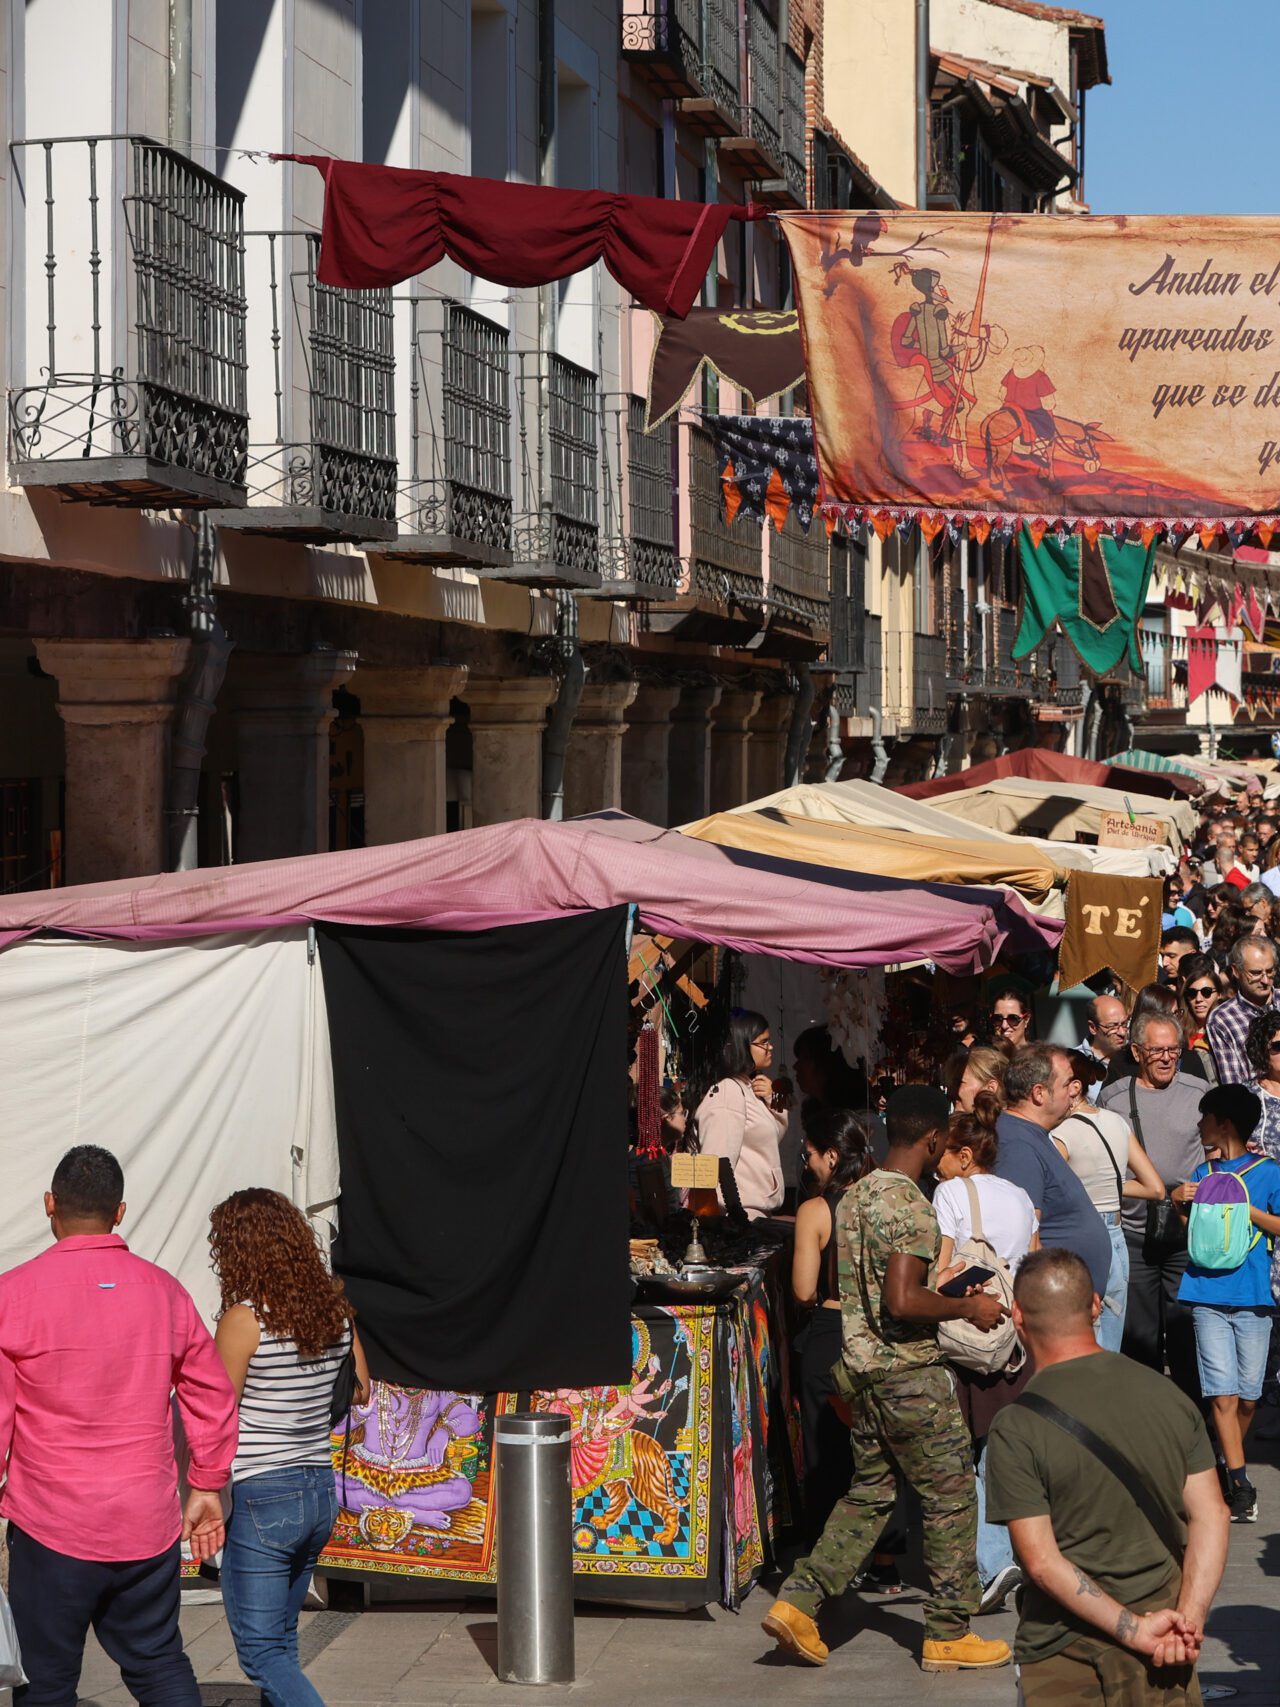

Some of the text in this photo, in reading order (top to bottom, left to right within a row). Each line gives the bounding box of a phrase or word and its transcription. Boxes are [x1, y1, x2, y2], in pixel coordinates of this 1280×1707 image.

[1128, 253, 1241, 296] Andan
[1118, 315, 1274, 363] apareados
[1151, 383, 1207, 420] que
[1212, 384, 1248, 408] se
[1081, 895, 1150, 939] TÉ
